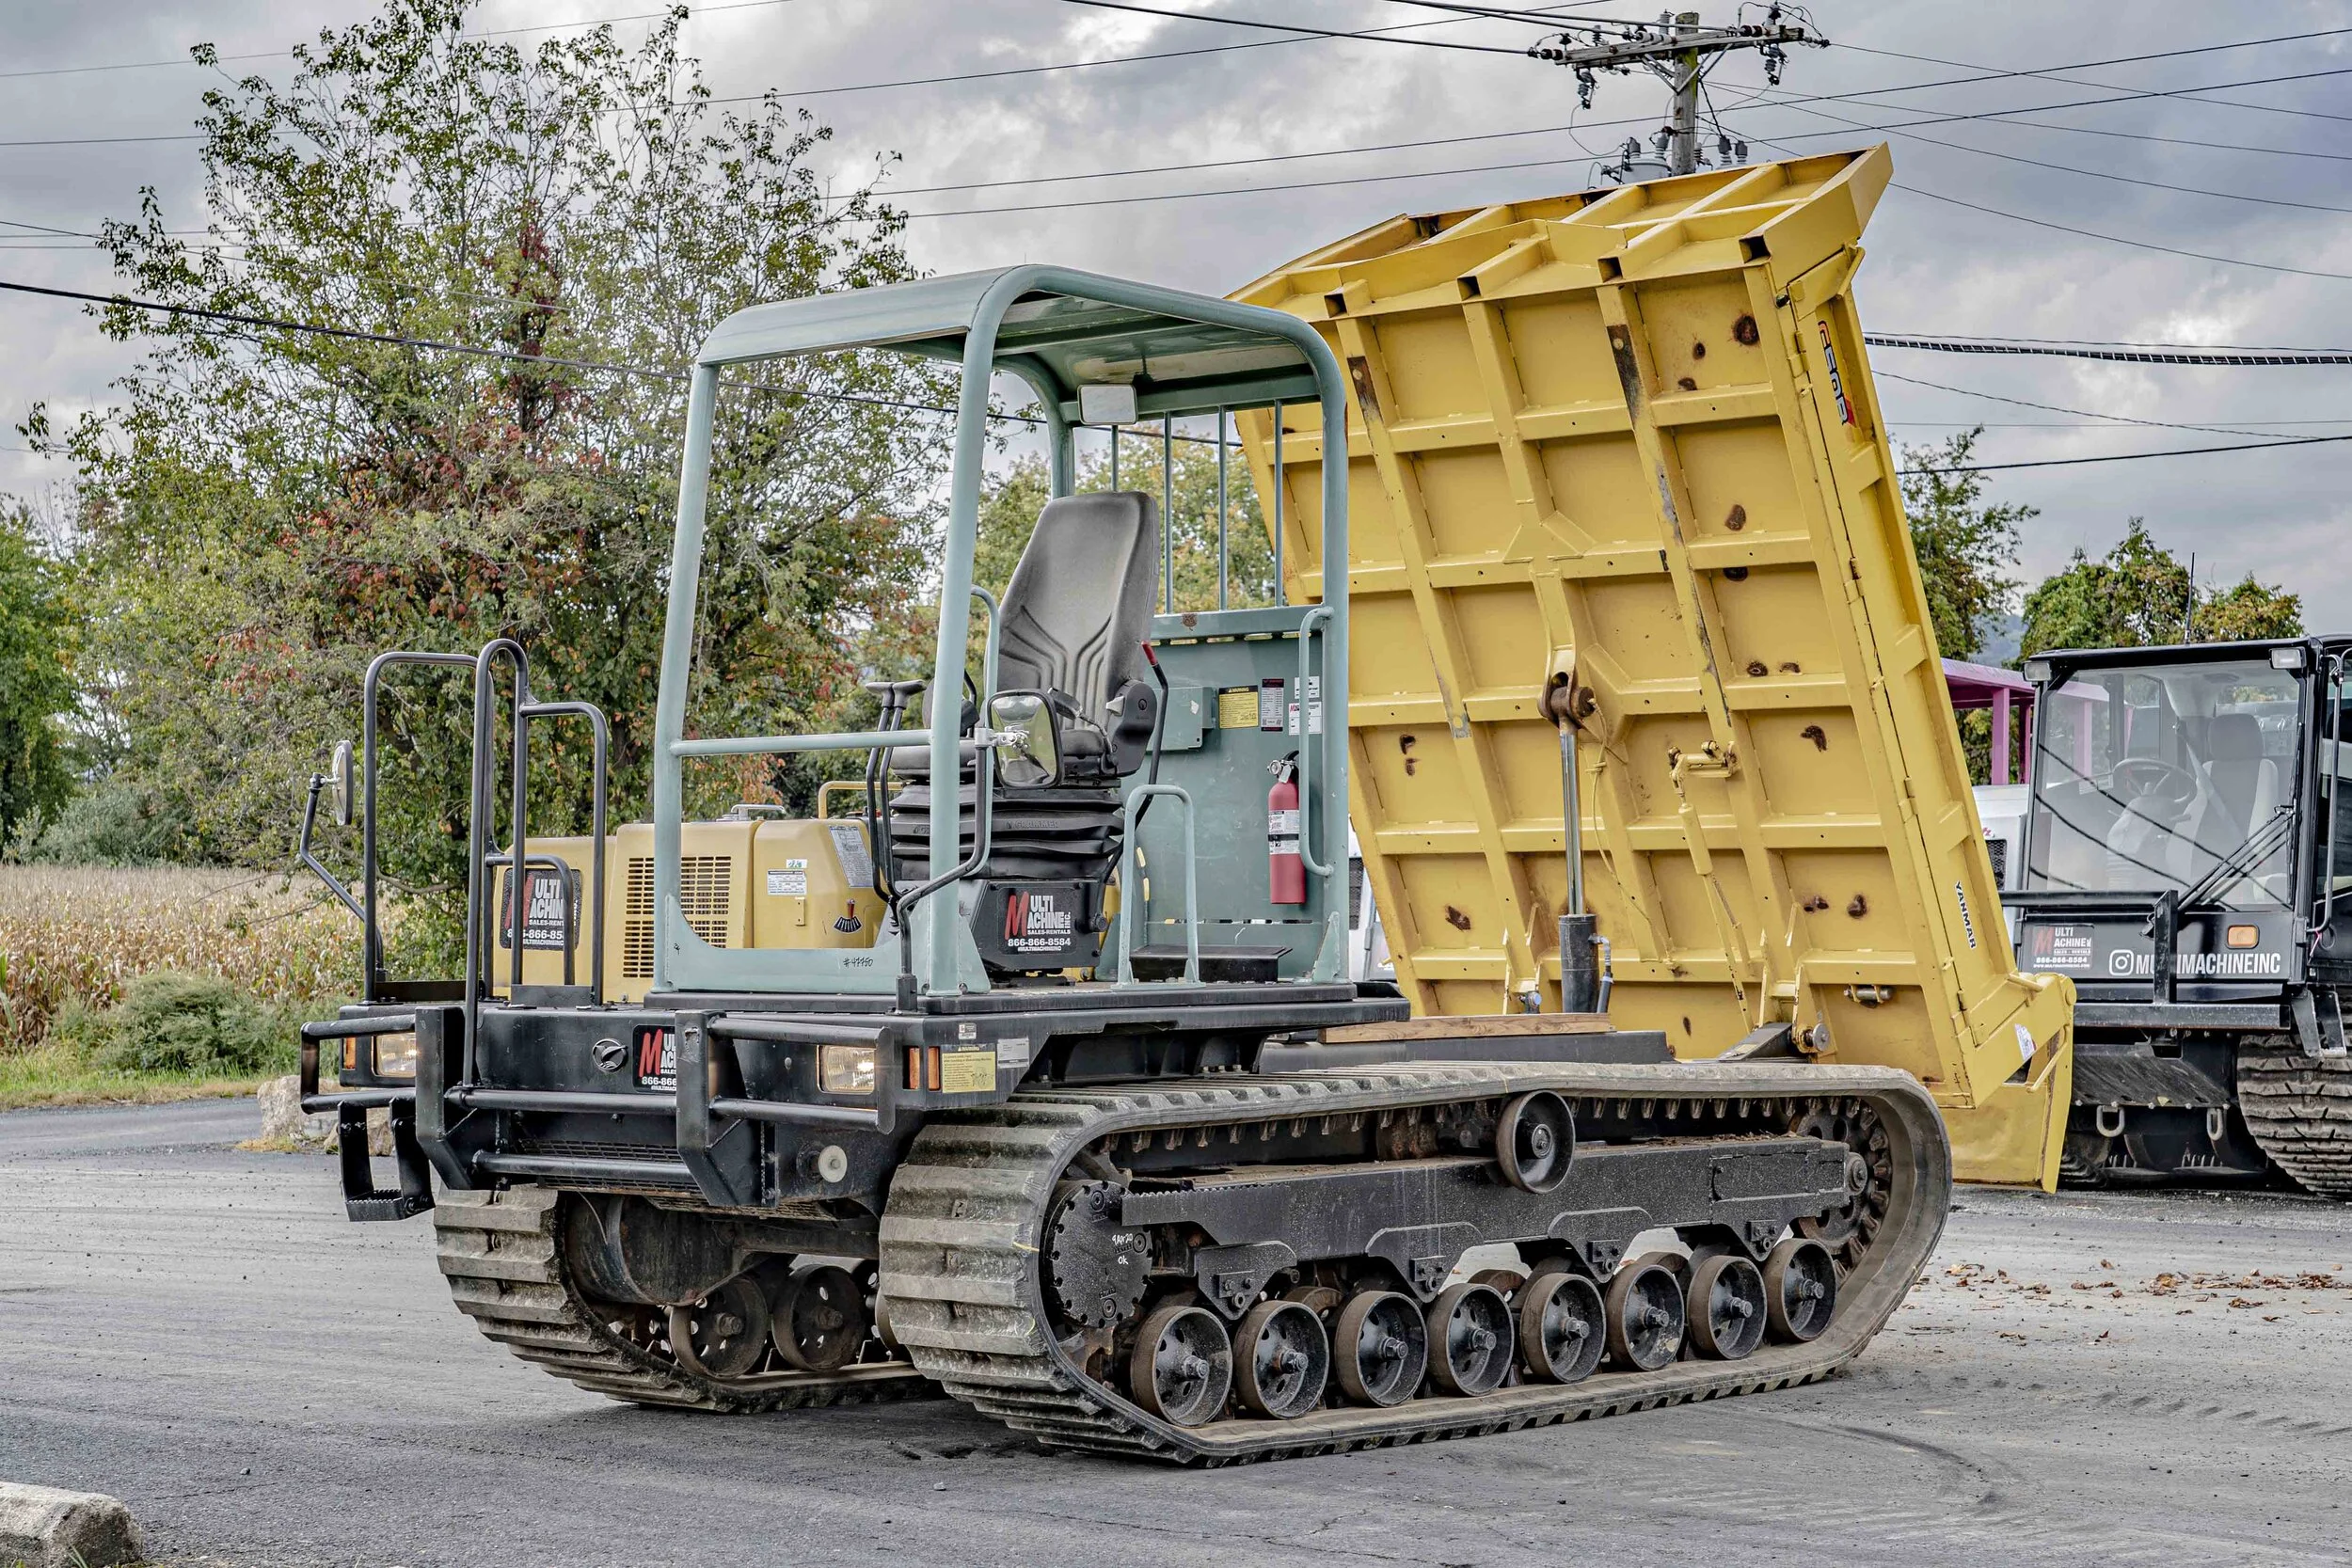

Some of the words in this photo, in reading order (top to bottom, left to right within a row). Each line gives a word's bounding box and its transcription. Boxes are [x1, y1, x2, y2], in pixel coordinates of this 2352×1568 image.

[1956, 880, 1977, 949] YANMAR
[1008, 938, 1072, 946] 866-866-8584
[2136, 953, 2281, 974] MUIMACHINEINC
[642, 1076, 676, 1085] 866-866
